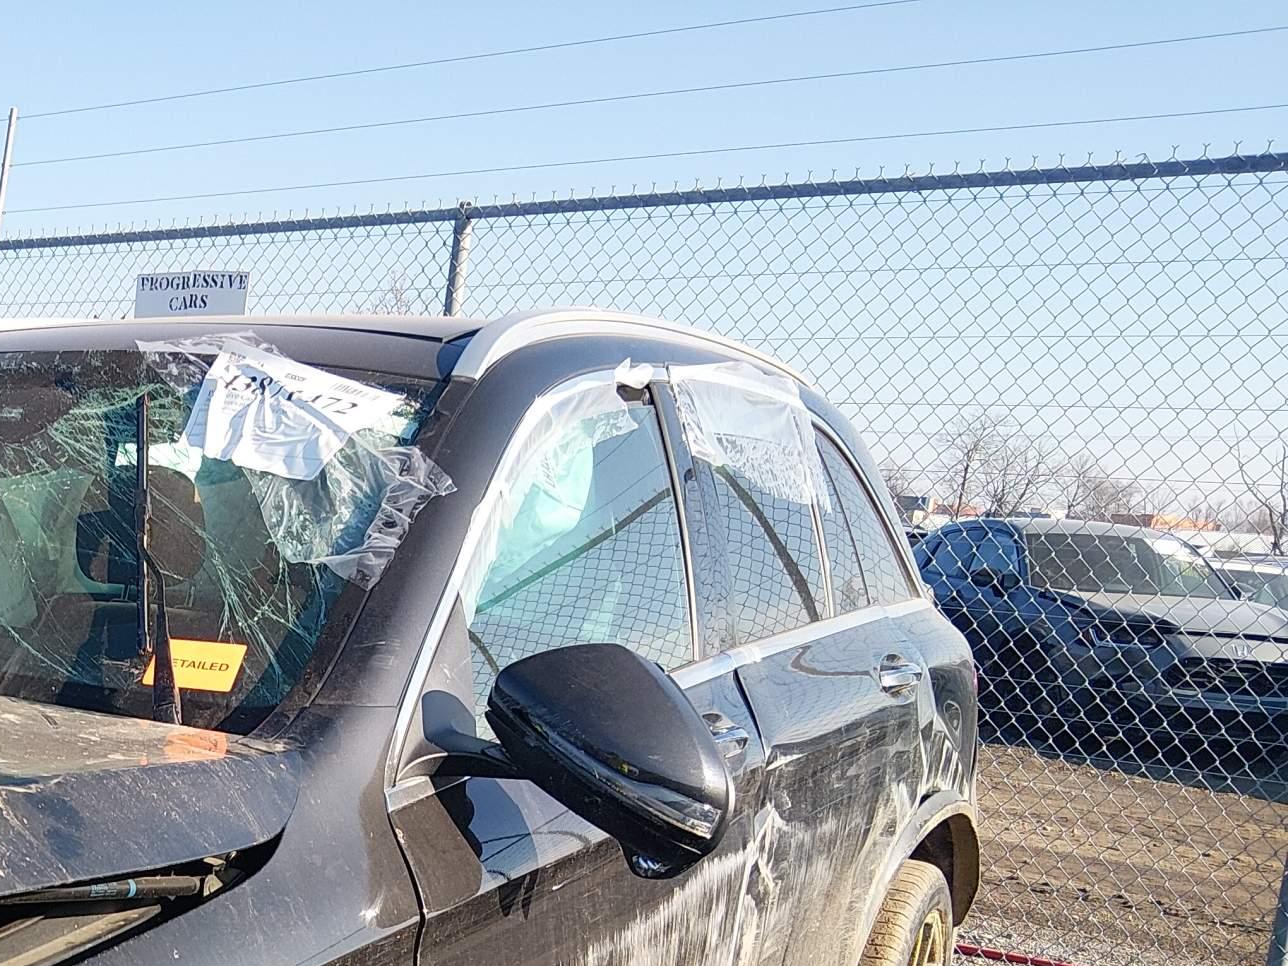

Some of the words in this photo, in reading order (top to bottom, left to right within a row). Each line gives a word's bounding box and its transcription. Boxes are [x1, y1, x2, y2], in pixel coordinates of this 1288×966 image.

[140, 272, 248, 291] PROGRESSIVE
[168, 293, 209, 312] CARS
[172, 658, 230, 671] ETAILED
